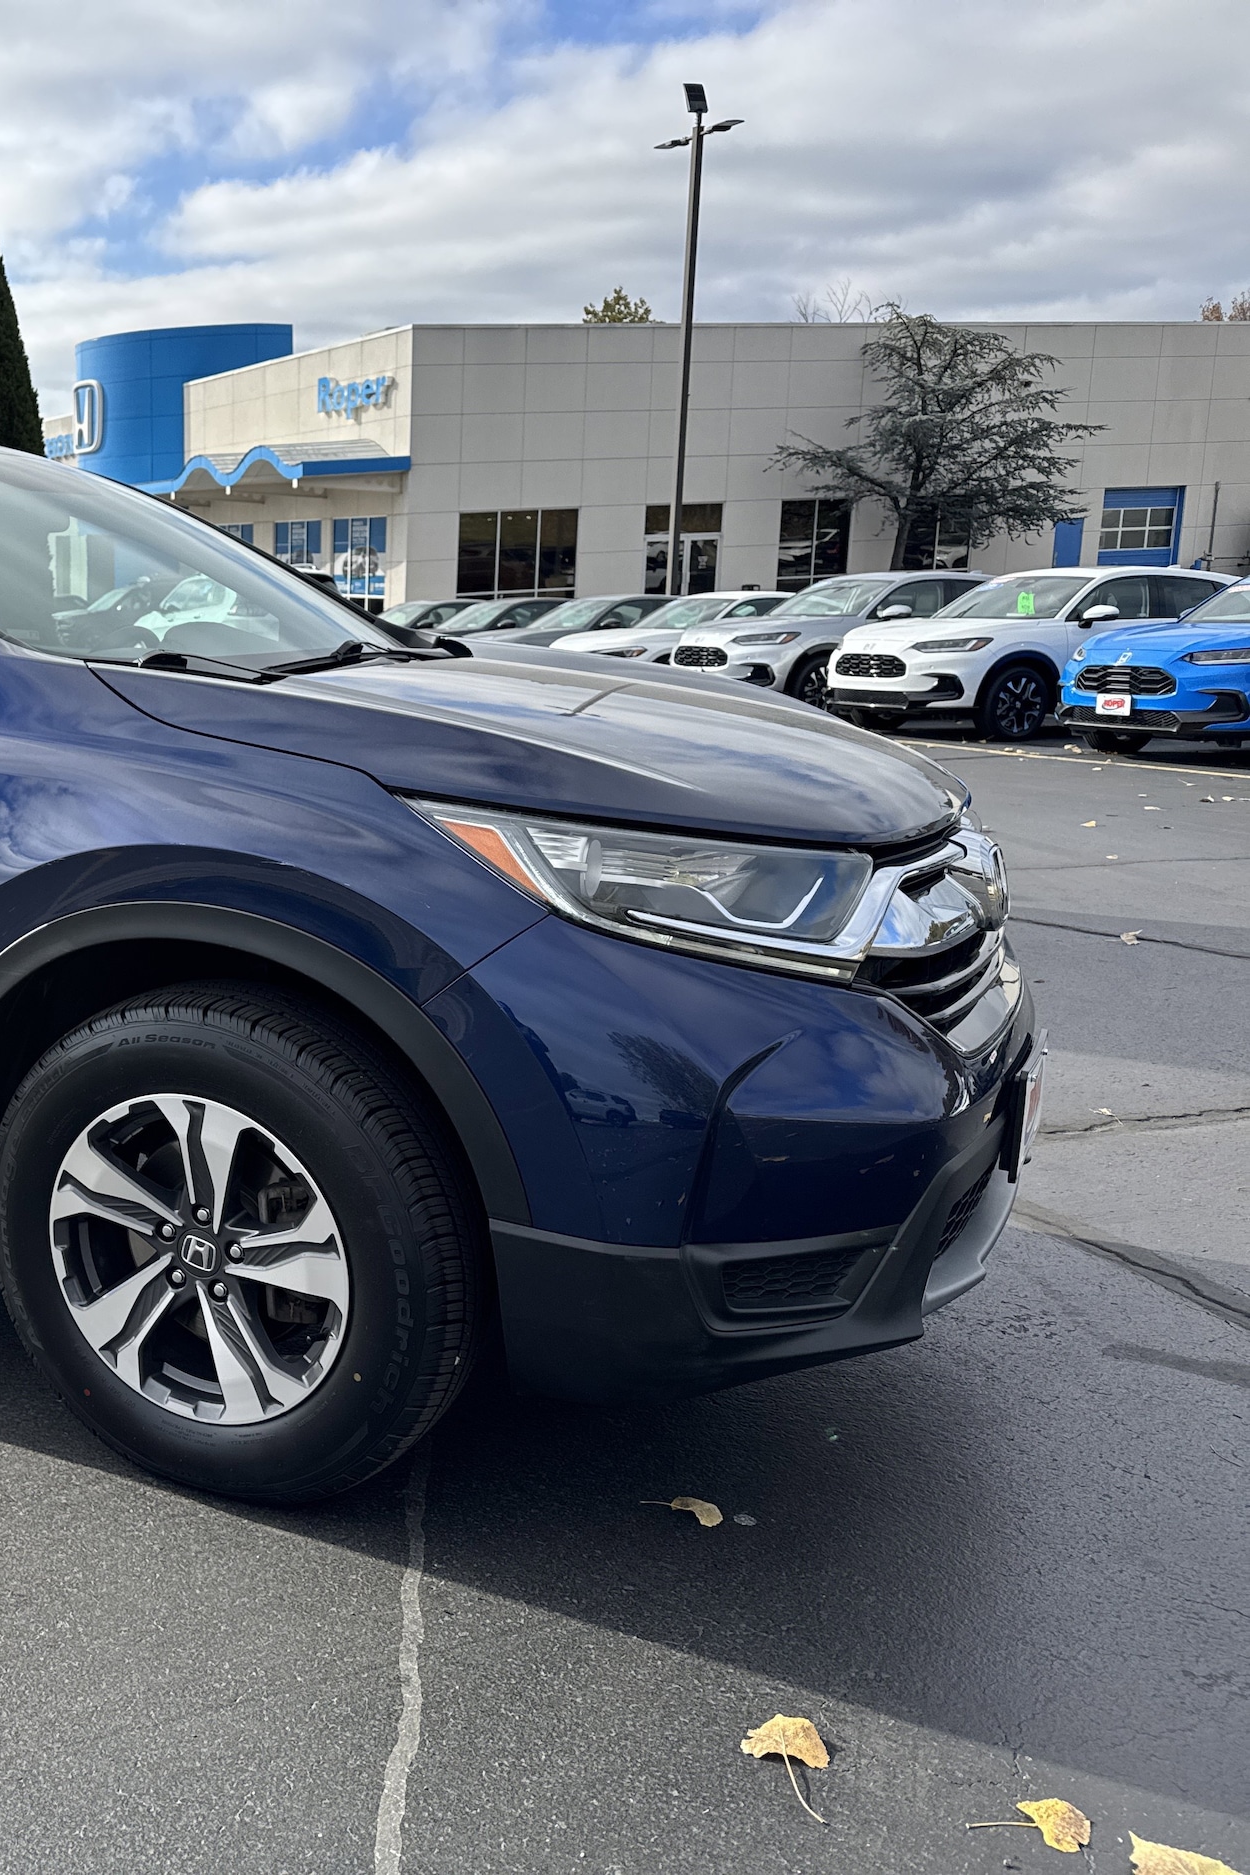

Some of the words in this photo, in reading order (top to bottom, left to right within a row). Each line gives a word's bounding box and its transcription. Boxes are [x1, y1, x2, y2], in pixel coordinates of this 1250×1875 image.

[318, 376, 388, 420] Roper
[117, 1035, 142, 1048] All
[143, 1033, 216, 1049] Season
[342, 1144, 414, 1414] BFGoodrich
